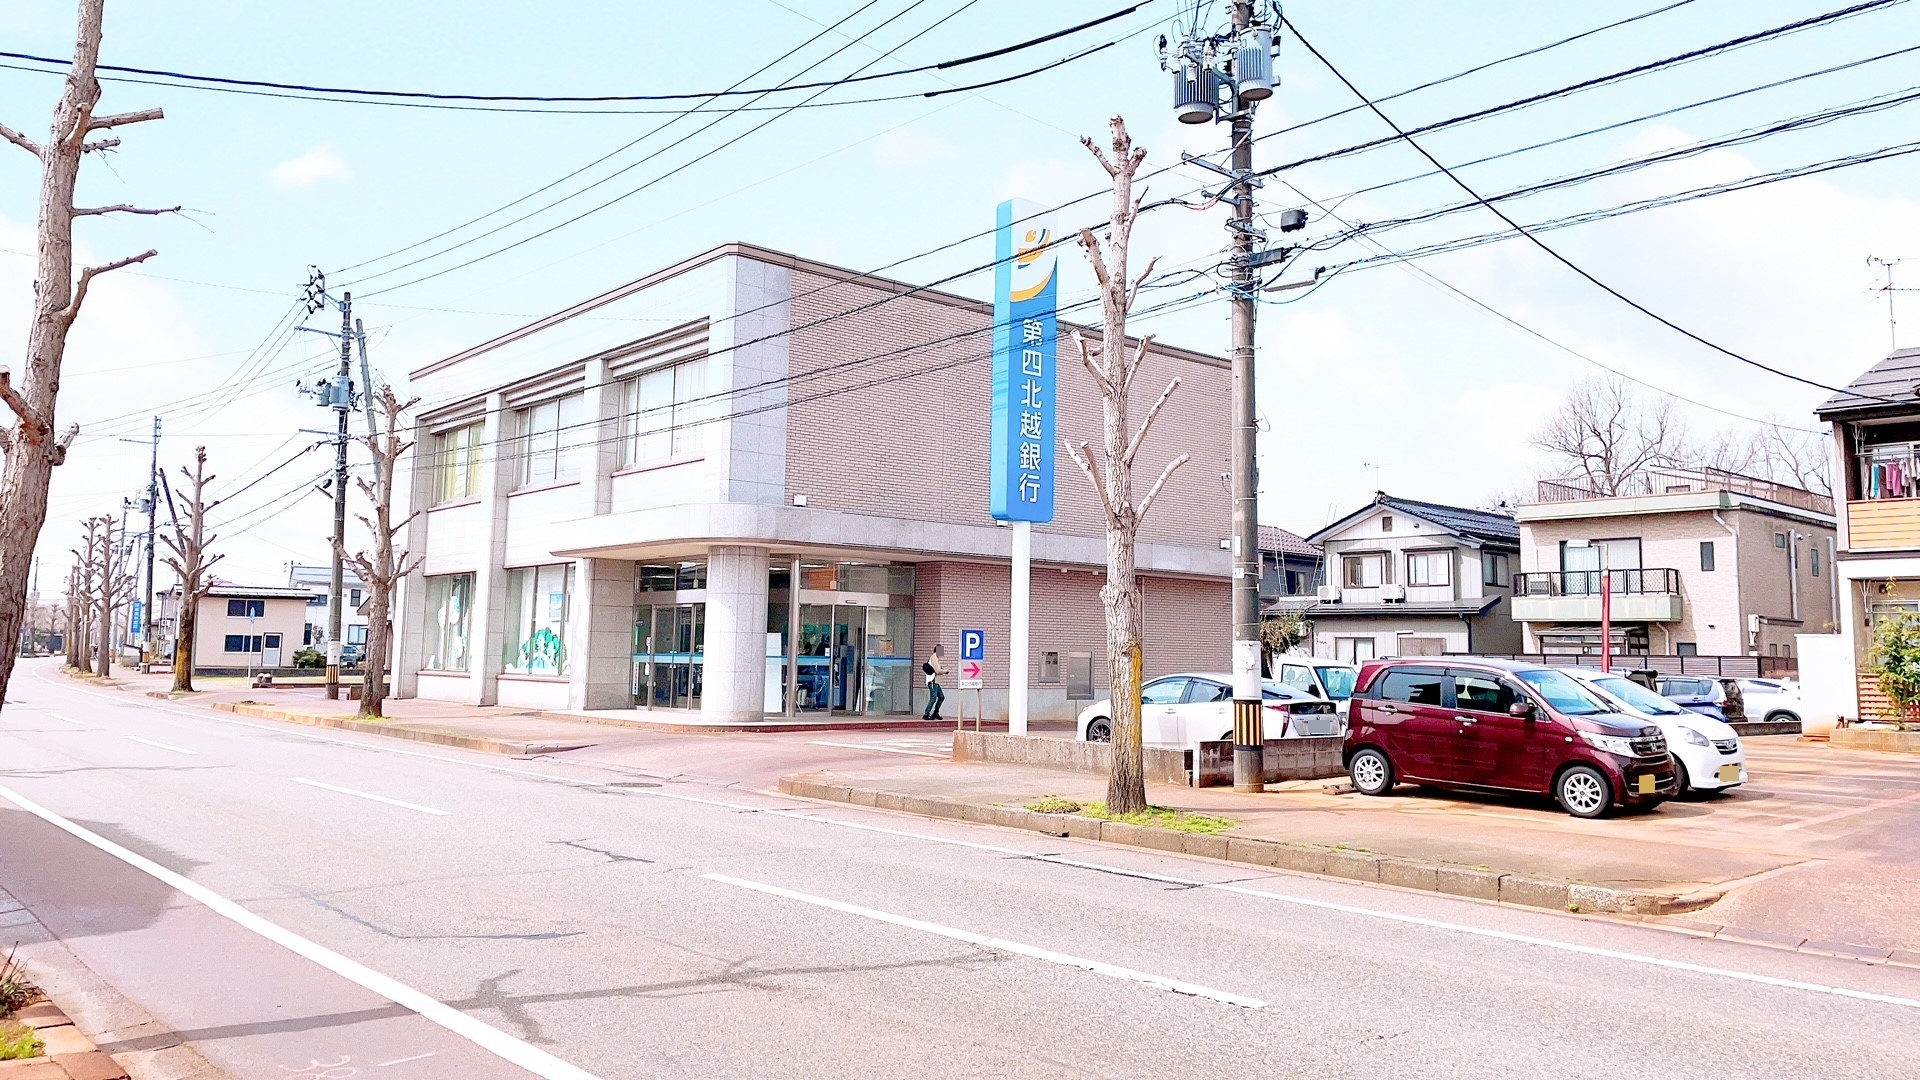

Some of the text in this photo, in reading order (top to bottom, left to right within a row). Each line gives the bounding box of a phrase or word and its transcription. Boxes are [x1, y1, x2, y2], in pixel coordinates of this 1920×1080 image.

[1019, 318, 1044, 504] 第四北越銀行
[965, 632, 981, 658] P
